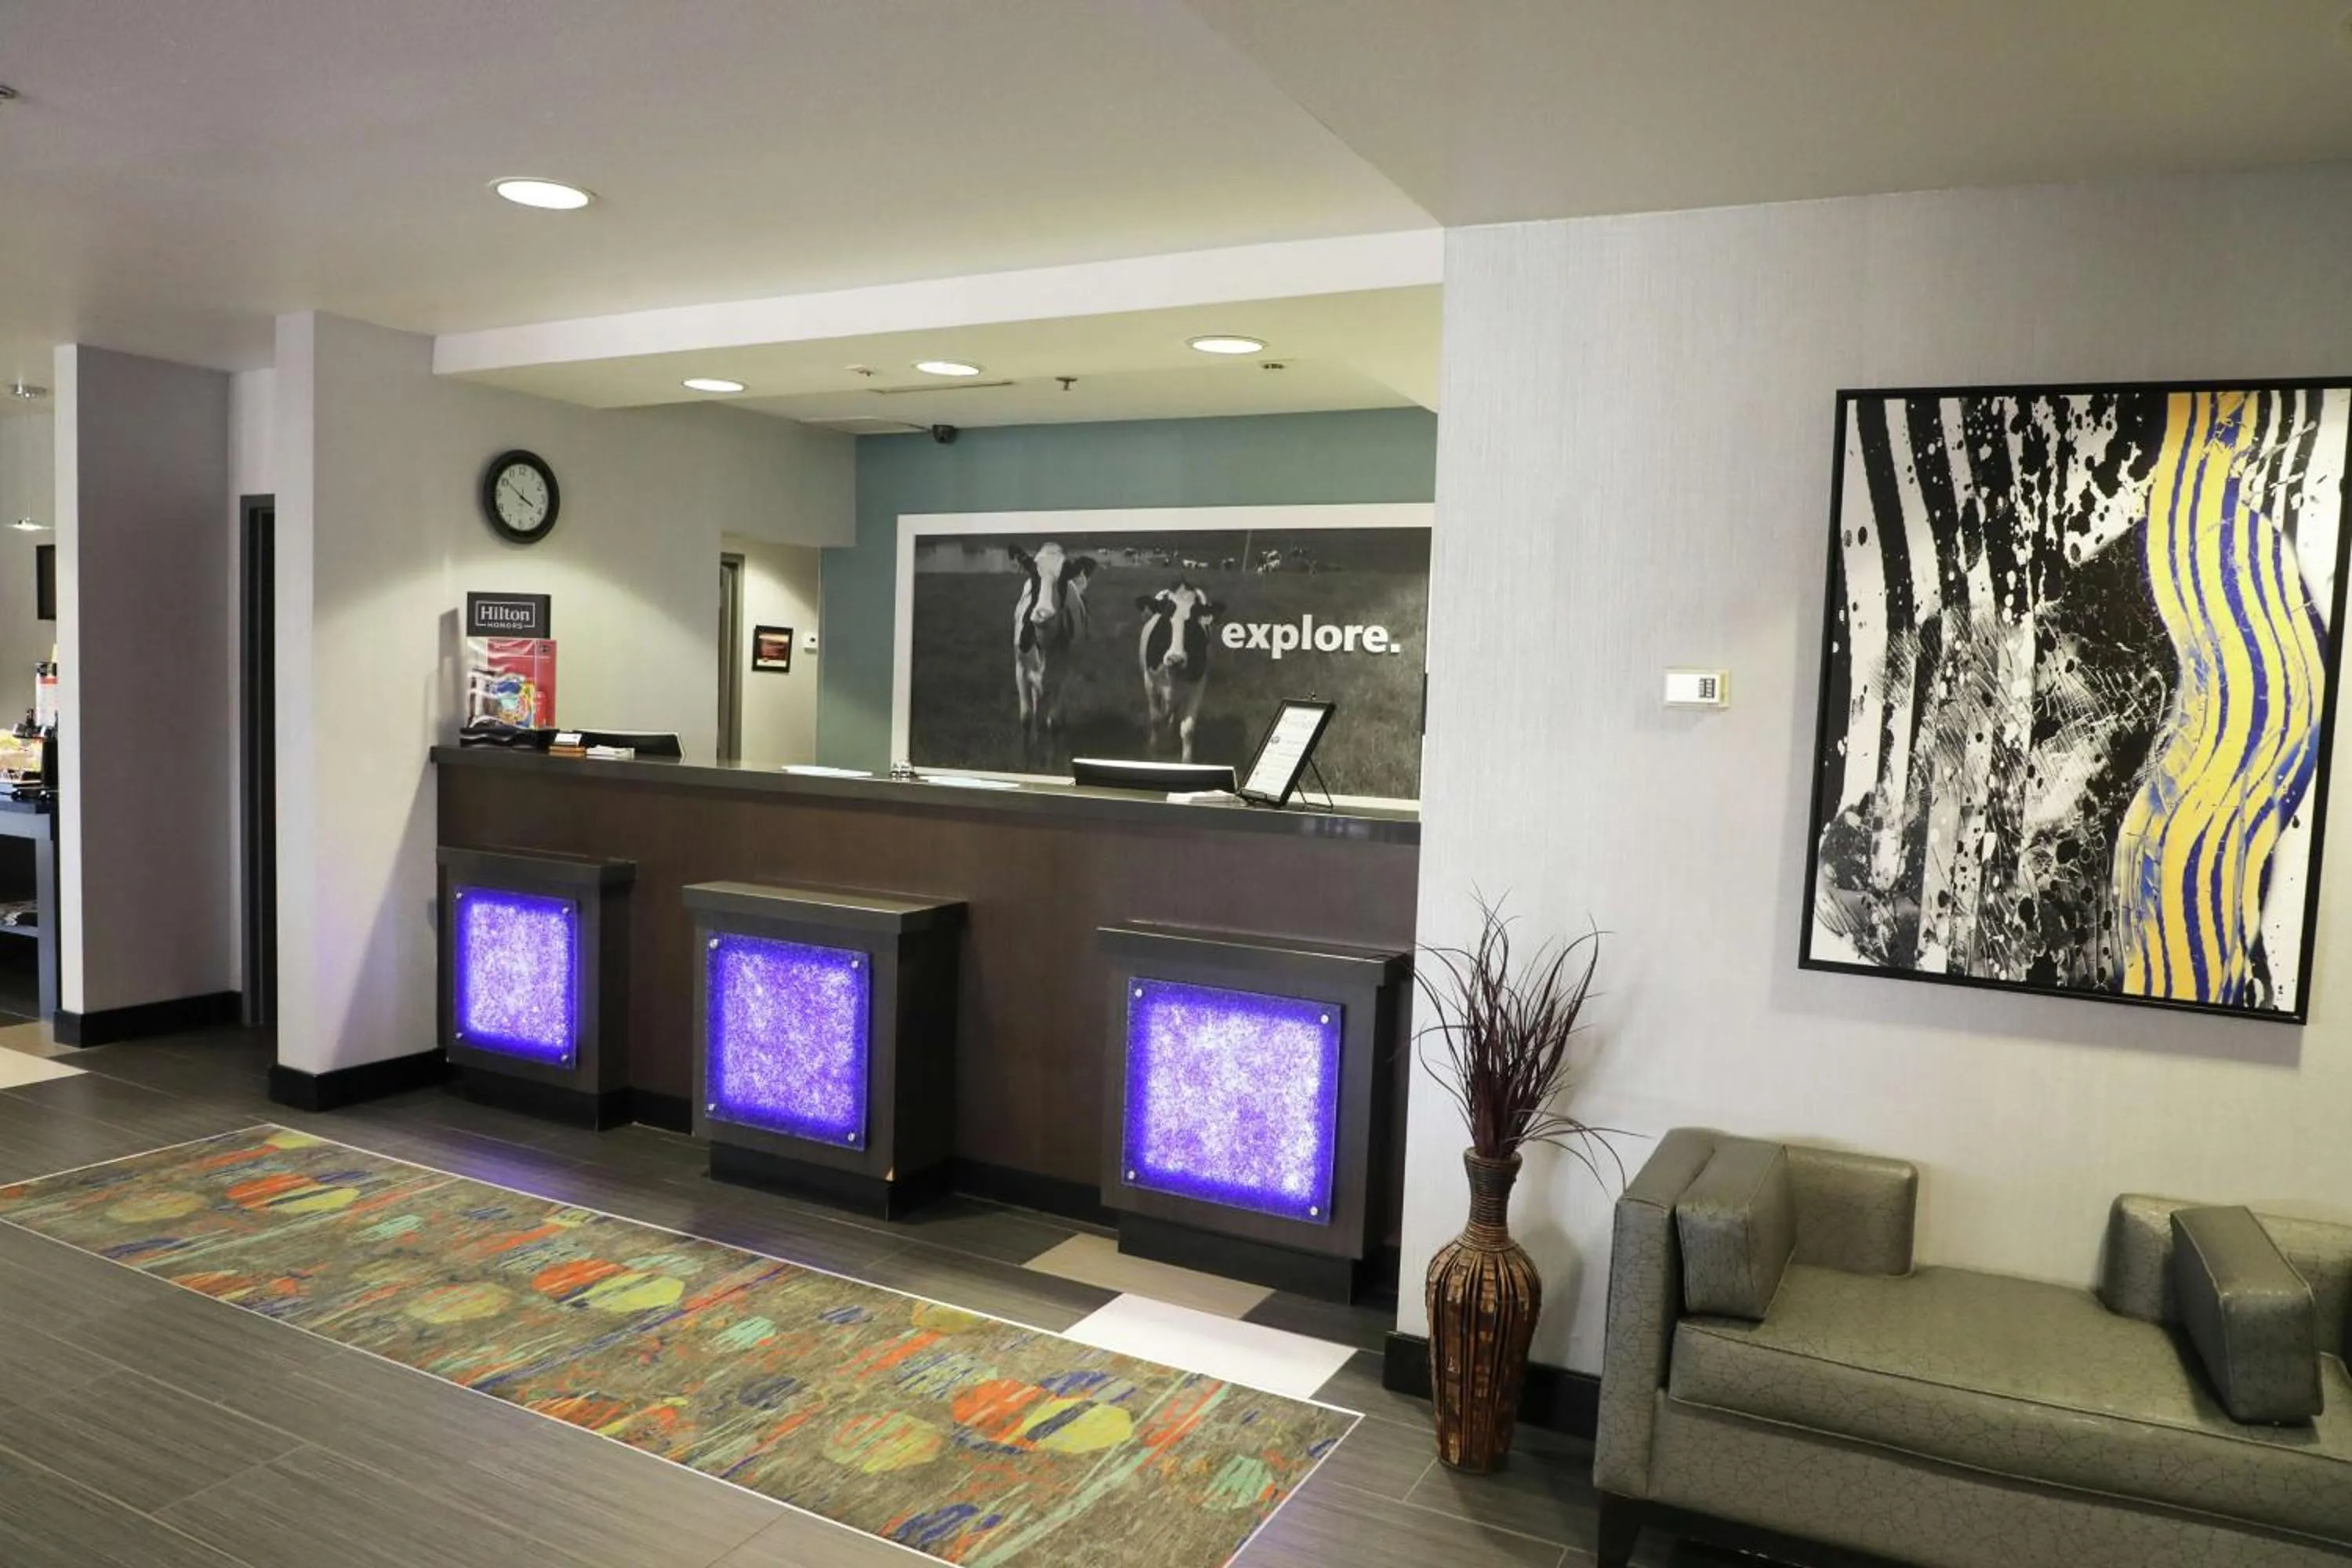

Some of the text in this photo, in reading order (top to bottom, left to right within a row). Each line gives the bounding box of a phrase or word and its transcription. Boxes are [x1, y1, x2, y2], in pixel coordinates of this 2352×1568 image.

[519, 466, 527, 476] 12
[481, 605, 530, 621] Hilton
[1221, 614, 1401, 659] explore.
